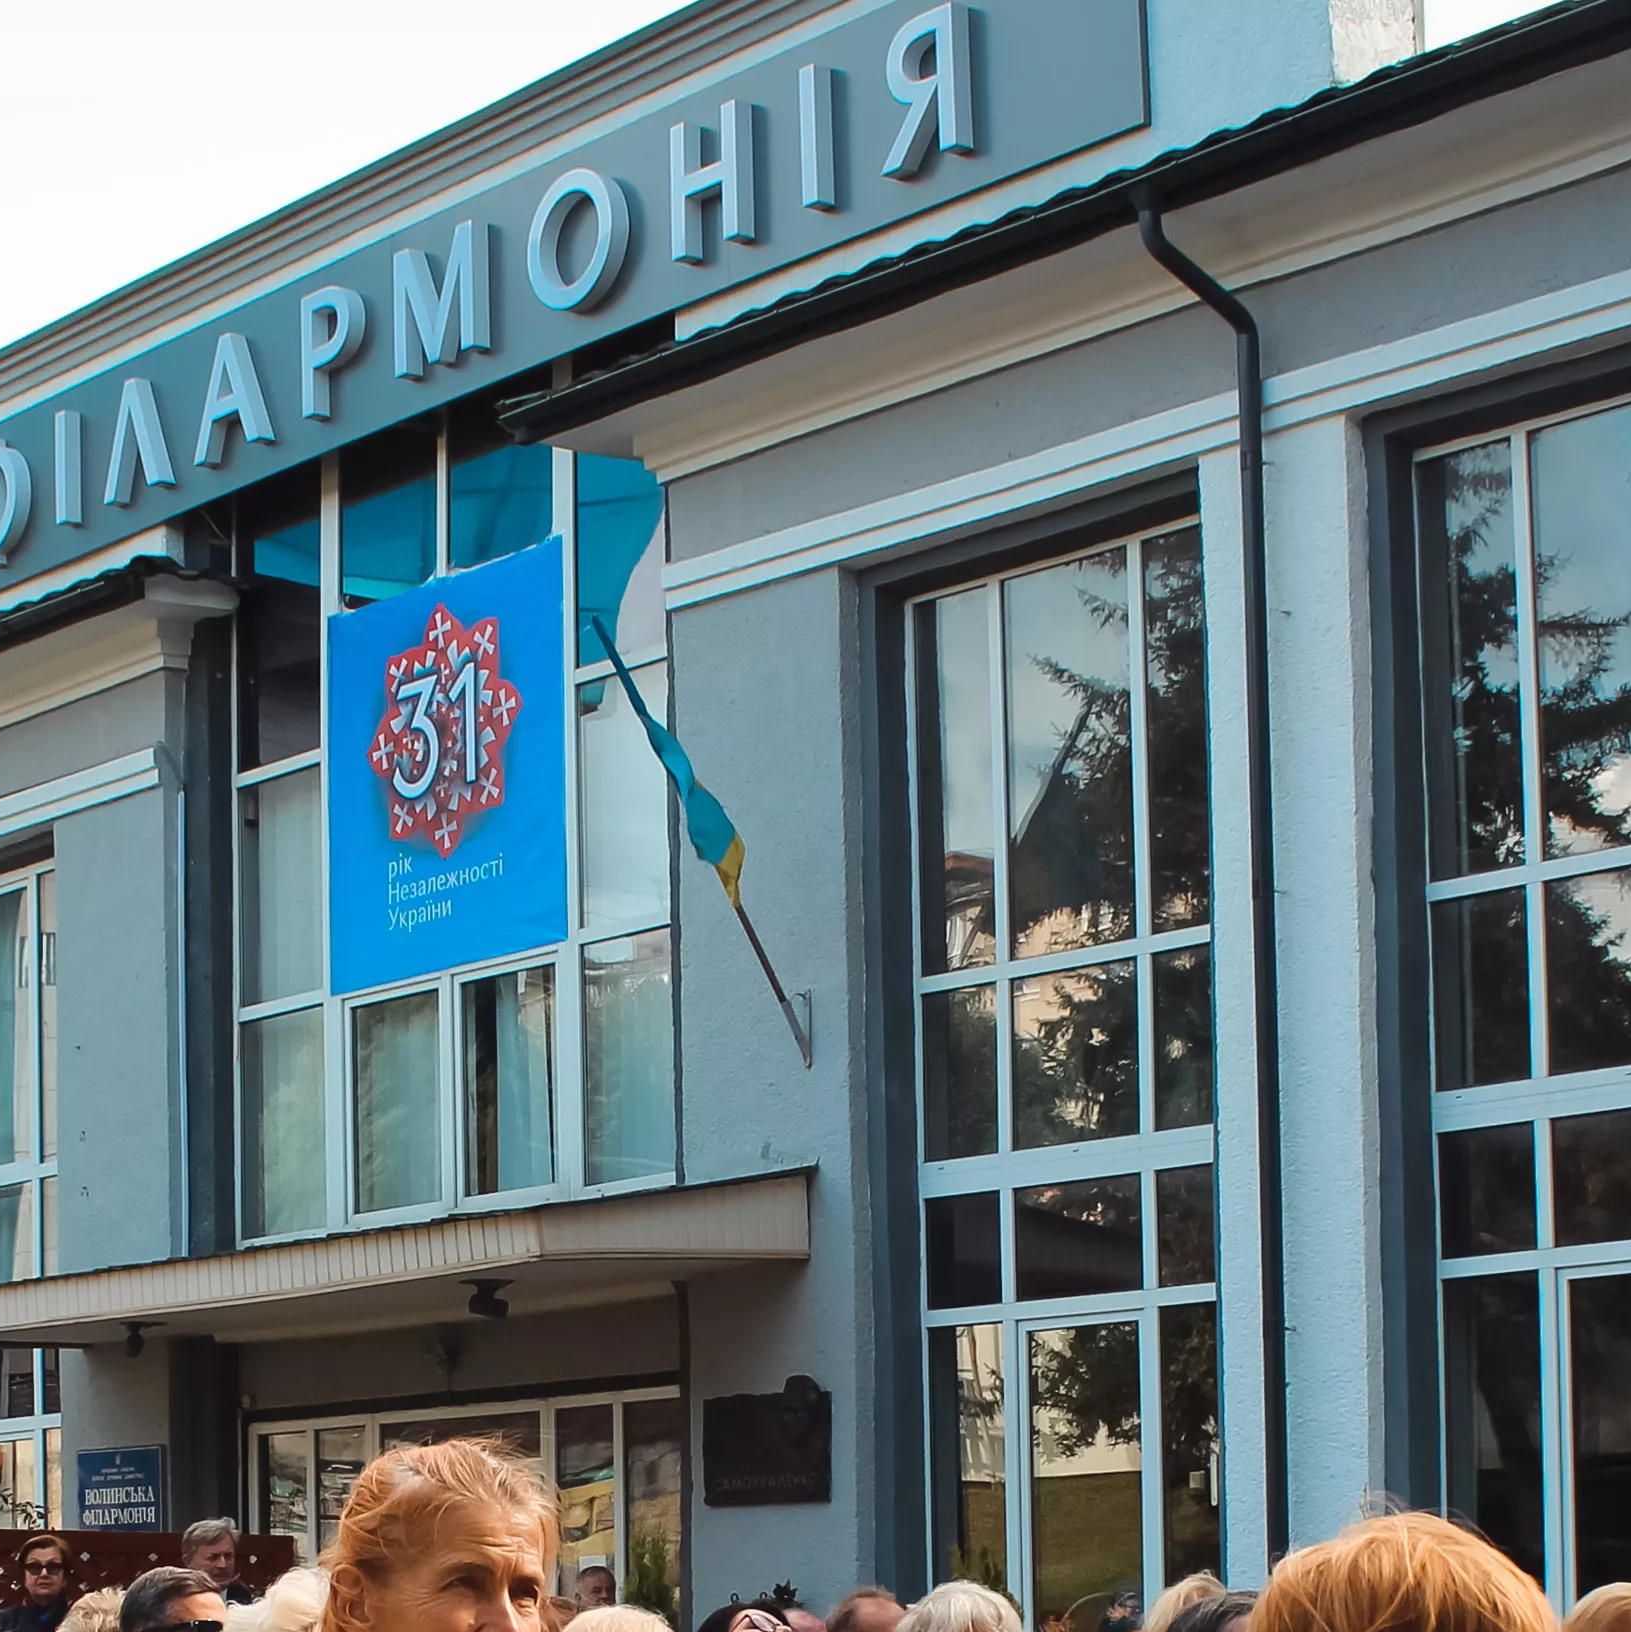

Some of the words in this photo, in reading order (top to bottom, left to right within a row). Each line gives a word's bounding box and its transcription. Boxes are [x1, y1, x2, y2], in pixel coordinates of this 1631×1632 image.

[392, 661, 478, 799] 31
[388, 852, 413, 883] рік
[388, 852, 504, 905] Незалежності
[388, 899, 452, 933] України
[84, 1485, 155, 1505] ВОЛИНСЬКА
[82, 1506, 156, 1525] ФІЛАРМОНІЯ
